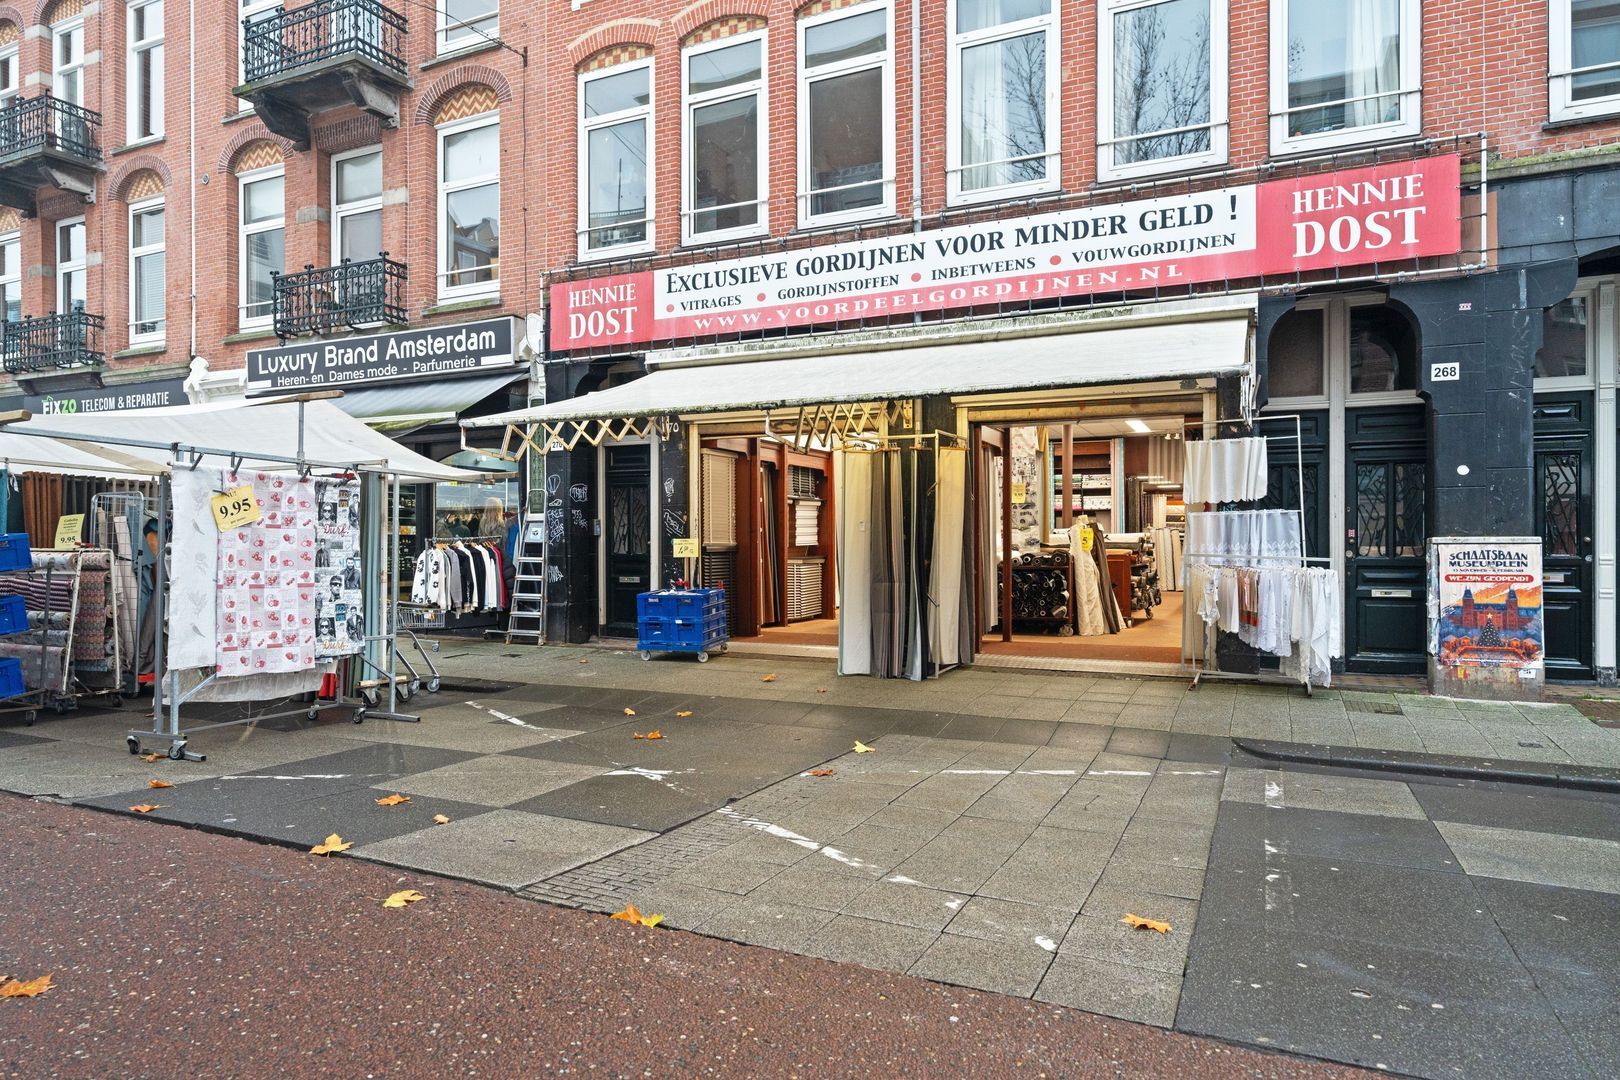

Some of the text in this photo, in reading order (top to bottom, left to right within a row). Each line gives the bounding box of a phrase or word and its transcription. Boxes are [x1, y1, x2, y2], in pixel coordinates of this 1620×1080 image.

[1292, 173, 1425, 215] HENNIE
[1292, 206, 1427, 258] DOST
[666, 261, 788, 294] EXCLUSIEVE
[796, 241, 926, 277] GORDIJNEN
[935, 230, 1005, 257] VOOR
[1014, 214, 1128, 248] MINDER
[1139, 203, 1214, 232] GELD
[680, 233, 1237, 312] VITRAGES GORDIJNSTOFFEN INBETWEENS VOUWGORDIJNEN
[569, 283, 637, 309] HENNIE
[569, 306, 638, 340] DOST
[258, 328, 496, 375] Luxury Brand Amsterdam
[277, 374, 310, 387] Heren-
[311, 374, 324, 384] en
[329, 368, 365, 382] Dames
[367, 364, 398, 379] mode
[413, 355, 476, 373] Parfumerie
[1434, 366, 1457, 378] 268
[81, 397, 116, 412] TELECOM
[117, 396, 125, 409] &
[126, 391, 170, 408] REPARATIE
[219, 498, 252, 520] 9.95
[60, 535, 76, 544] 9.95
[1448, 560, 1528, 568] MUSEUMPLEIN
[1449, 549, 1528, 560] SCHAATSBAAN
